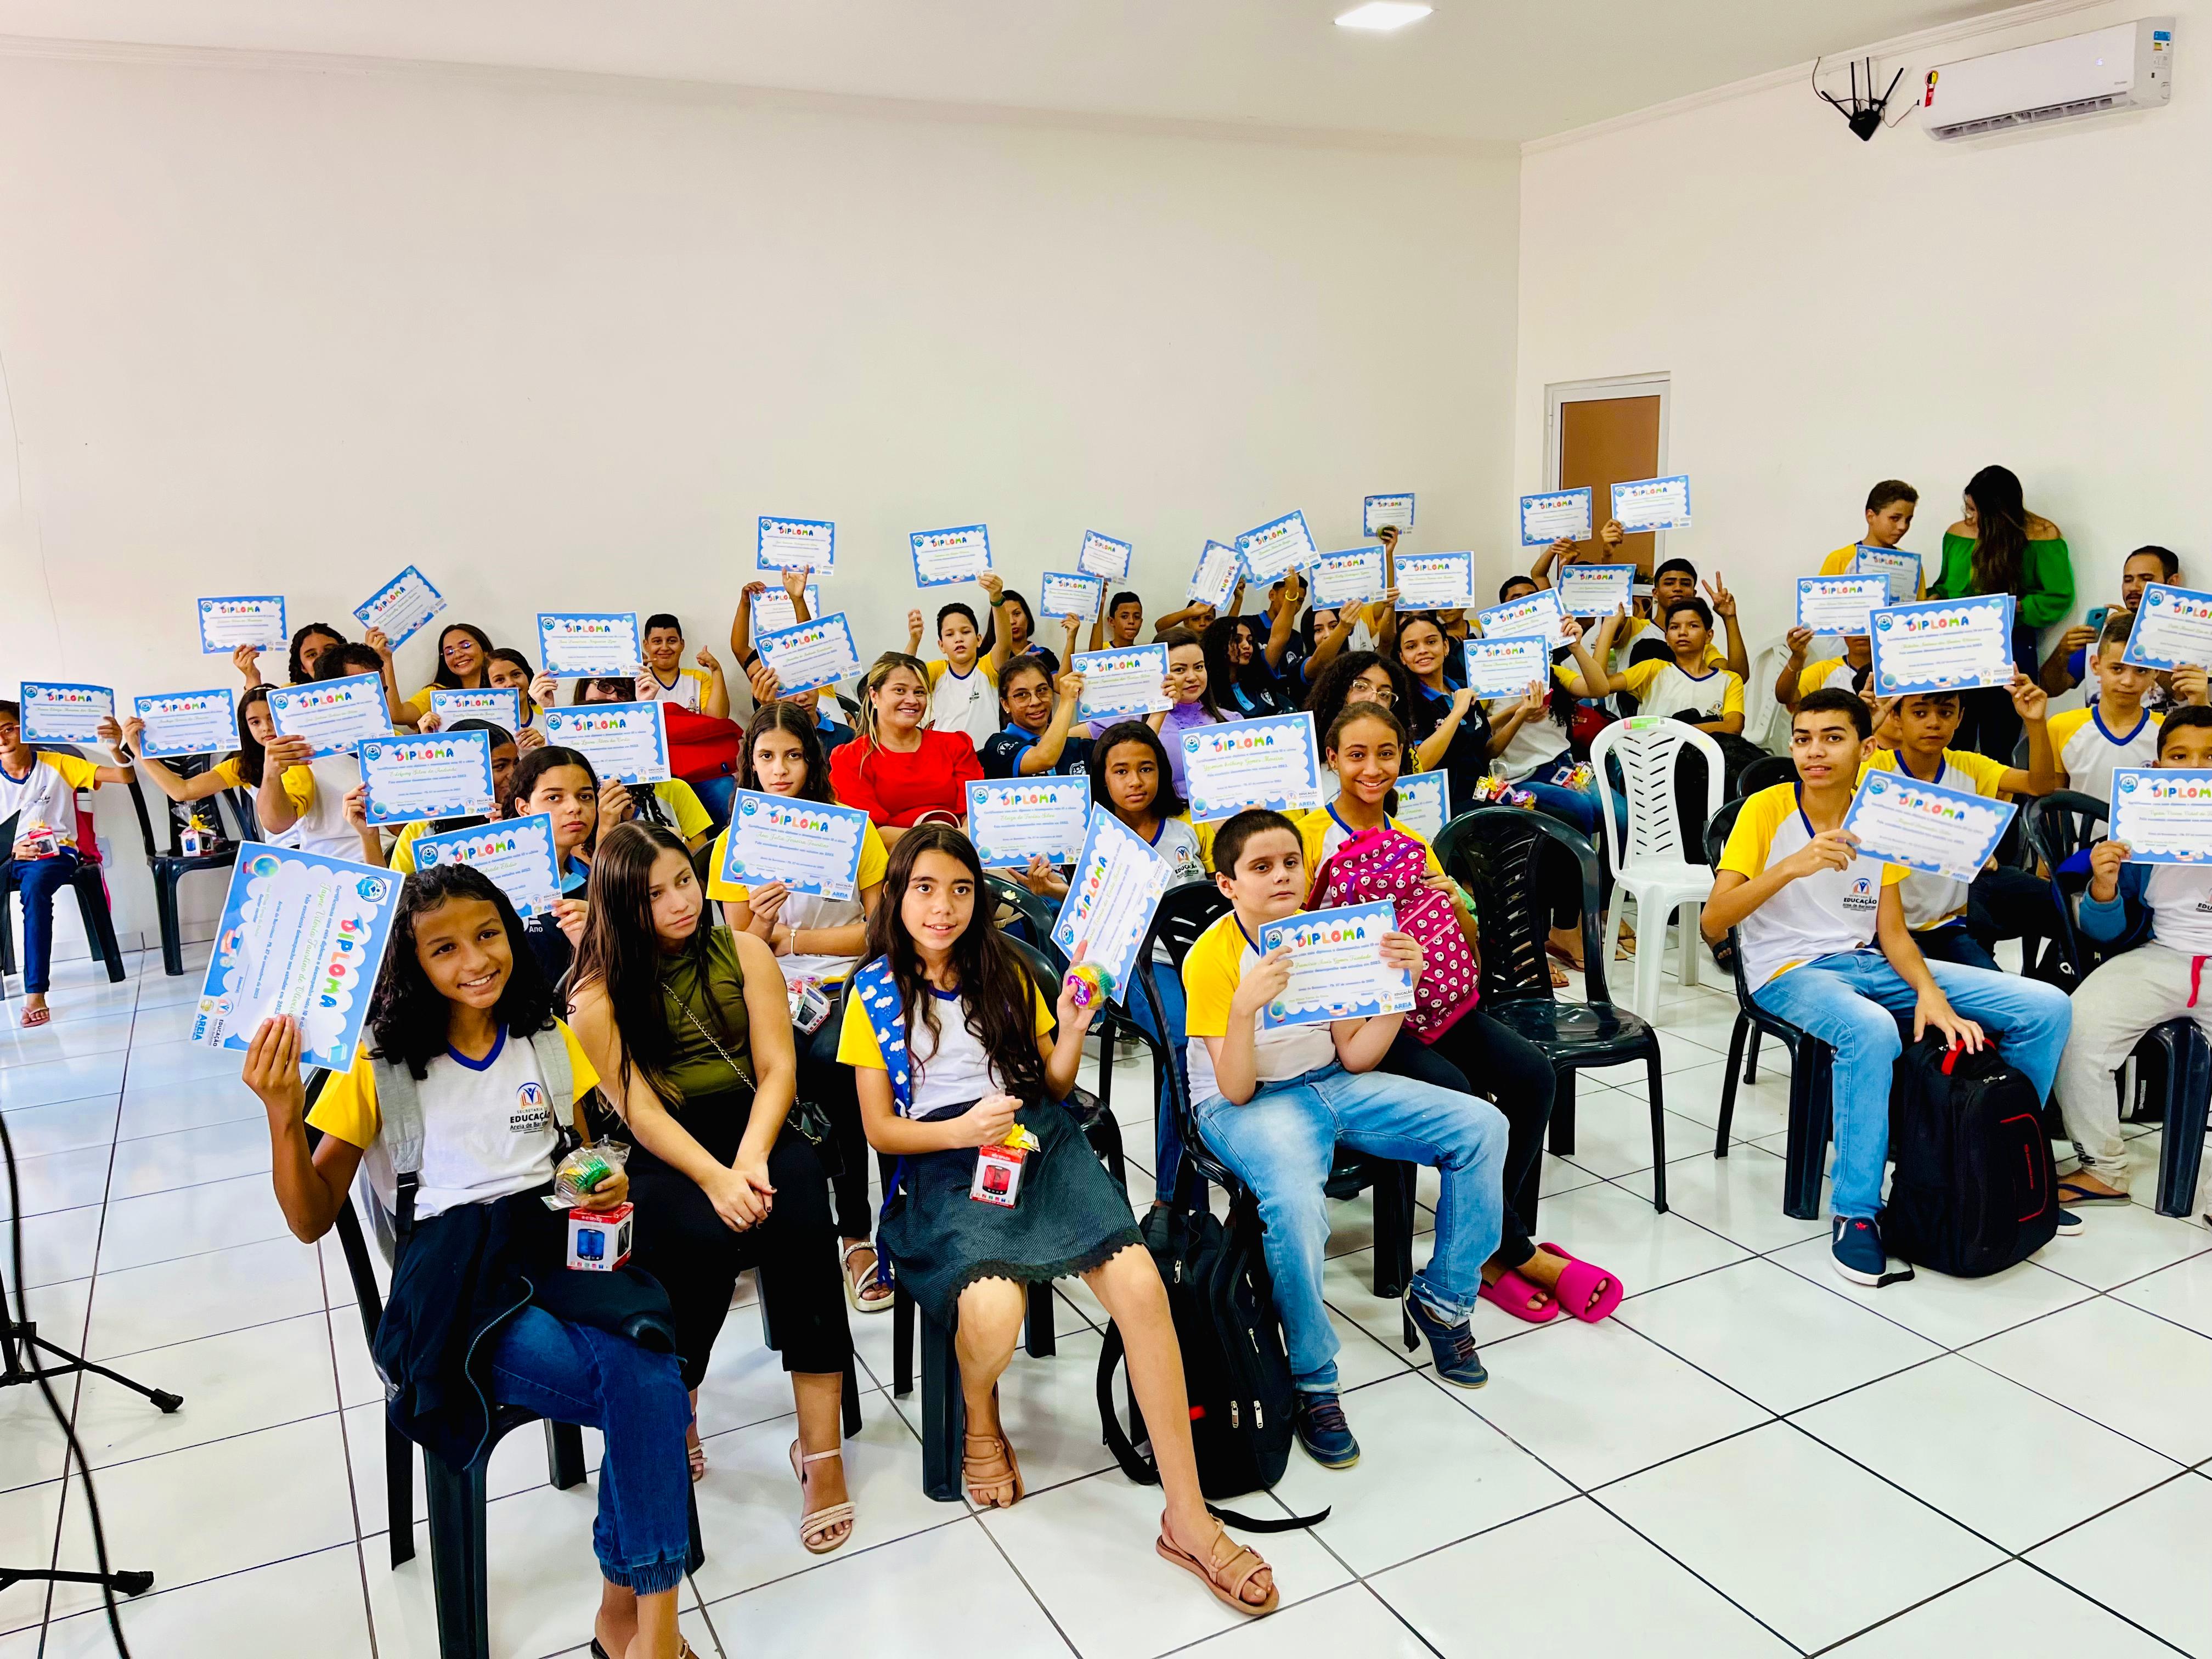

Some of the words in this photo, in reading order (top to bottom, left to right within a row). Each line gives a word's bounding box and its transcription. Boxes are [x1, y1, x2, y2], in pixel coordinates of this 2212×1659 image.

[1633, 487, 1667, 496] DIPLOMA
[1541, 500, 1572, 510] DIPLOMA
[780, 528, 813, 536] DIPLOMA
[1257, 528, 1288, 545] DIPLOMA
[932, 537, 967, 547] DIPLOMA
[1094, 540, 1115, 552] DIPLOMA
[1330, 559, 1364, 569] DIPLOMA
[1059, 582, 1086, 590] DIPLOMA
[1221, 566, 1234, 592] DIPLOMA
[376, 586, 405, 612] DIPLOMA
[1822, 586, 1863, 596] DIPLOMA
[1501, 604, 1537, 623] DIPLOMA
[1908, 615, 1968, 631] DIPLOMA
[783, 630, 825, 649] DIPLOMA
[1487, 646, 1524, 658] DIPLOMA
[1098, 659, 1140, 672] DIPLOMA
[48, 692, 92, 703] DIPLOMA
[302, 692, 352, 708] DIPLOMA
[456, 698, 494, 707] DIPLOMA
[162, 702, 206, 713] DIPLOMA
[575, 719, 627, 731] DIPLOMA
[1215, 735, 1274, 752] DIPLOMA
[396, 748, 454, 761] DIPLOMA
[1002, 793, 1057, 805] DIPLOMA
[2153, 787, 2212, 798] DIPLOM
[1898, 794, 1965, 821] DIPLOMA
[770, 814, 828, 832] DIPLOMA
[455, 839, 516, 862] DIPLOMA
[1080, 855, 1108, 920] DIPLOMA
[328, 884, 342, 917] Certificamos
[297, 905, 308, 928] excelente
[325, 917, 333, 929] com
[322, 929, 330, 940] este
[1298, 927, 1365, 947] DIPLOMA
[288, 929, 302, 960] desempenho
[316, 940, 327, 961] diploma
[299, 937, 318, 972] Faustino
[319, 919, 357, 1007] DIPLOMA
[280, 970, 290, 990] estudos
[296, 973, 307, 983] de
[306, 965, 320, 997] desempenho
[278, 990, 285, 998] em
[286, 983, 305, 1018] Oliveira
[1394, 1001, 1412, 1010] AREIA
[194, 1014, 207, 1041] AREIA
[213, 1019, 224, 1047] EDUCAÇÃO
[510, 1110, 550, 1123] EDUCAÇÃO
